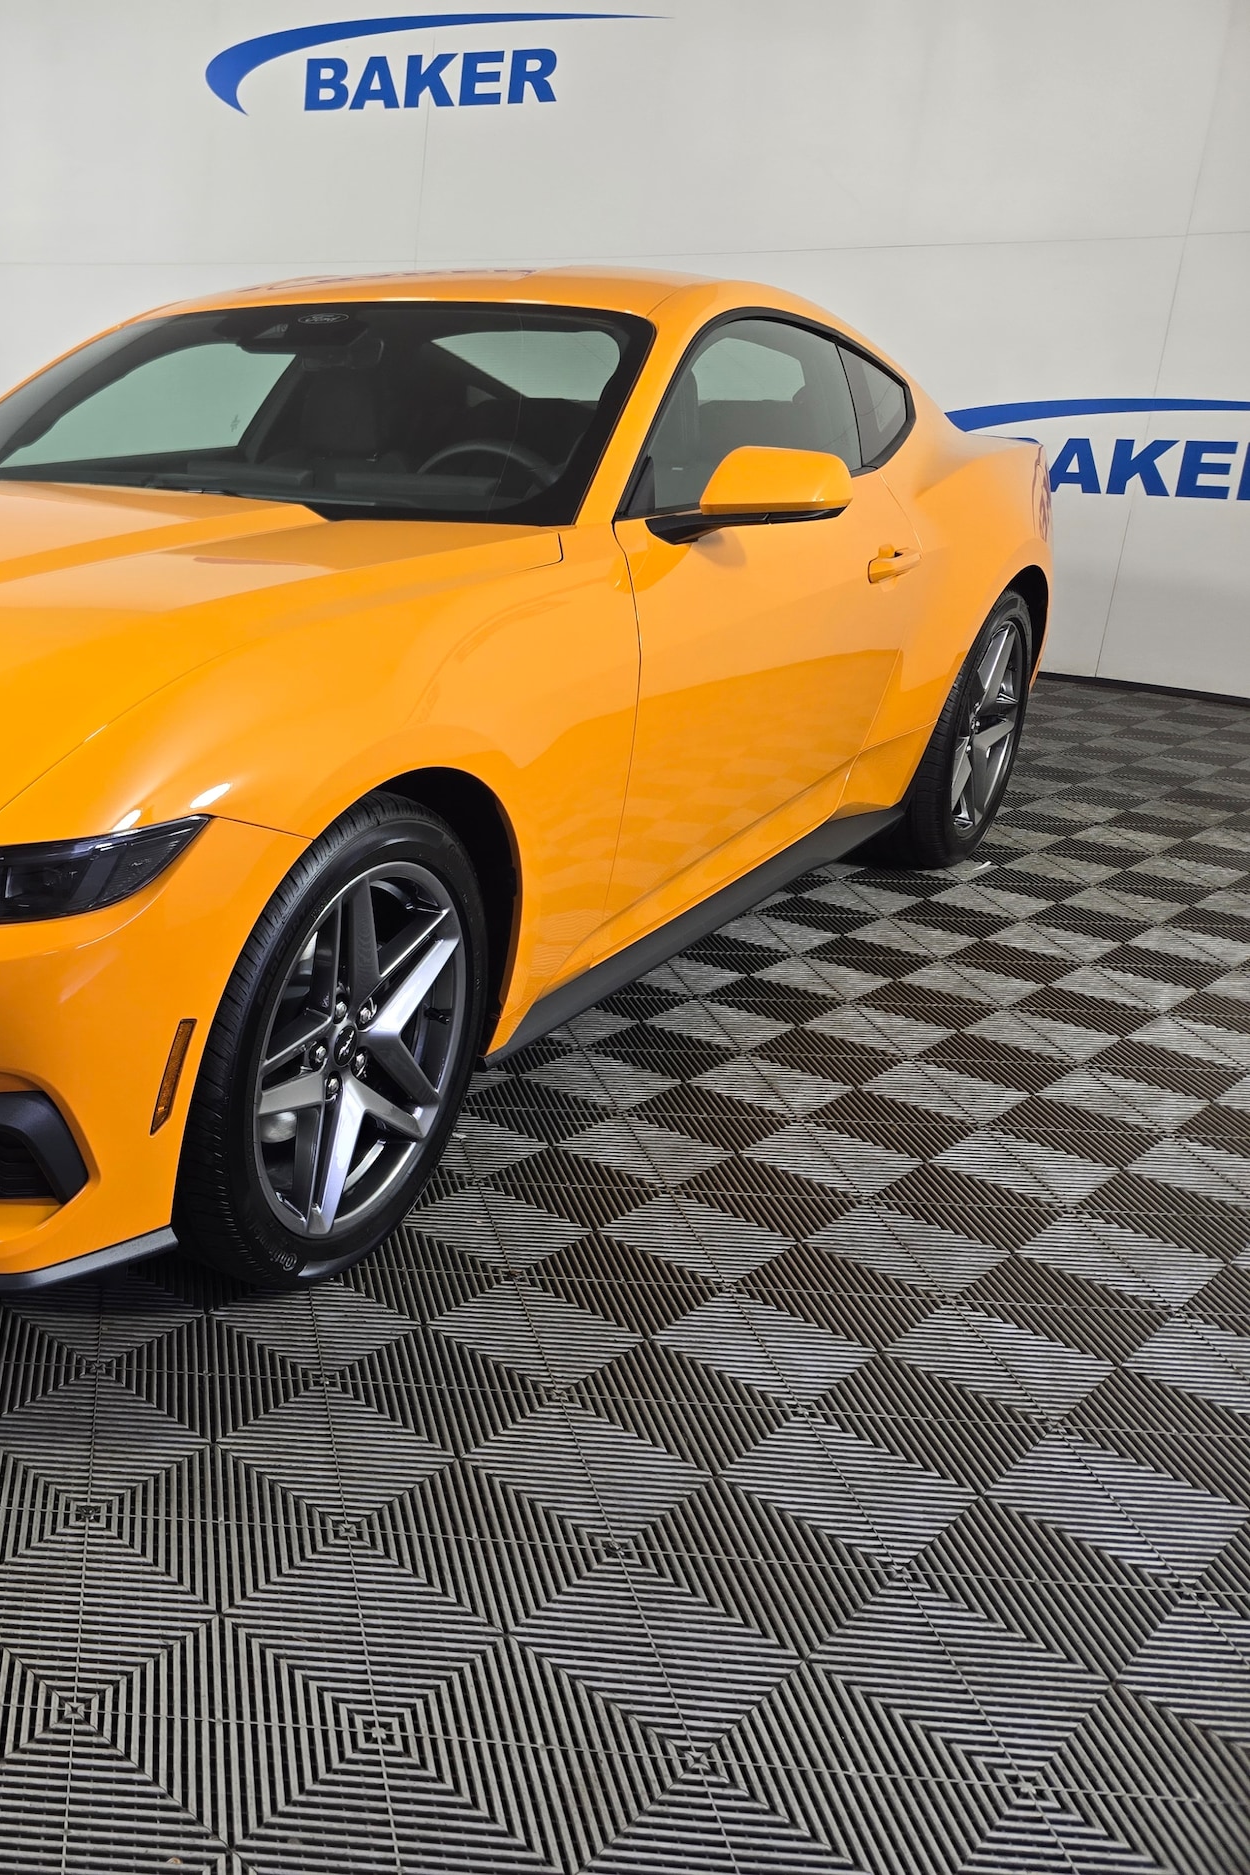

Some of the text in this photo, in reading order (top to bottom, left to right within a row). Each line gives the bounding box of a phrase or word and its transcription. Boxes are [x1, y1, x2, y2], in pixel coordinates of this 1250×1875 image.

[303, 48, 558, 112] BAKER
[304, 313, 342, 324] Ford
[1014, 437, 1250, 500] AKE
